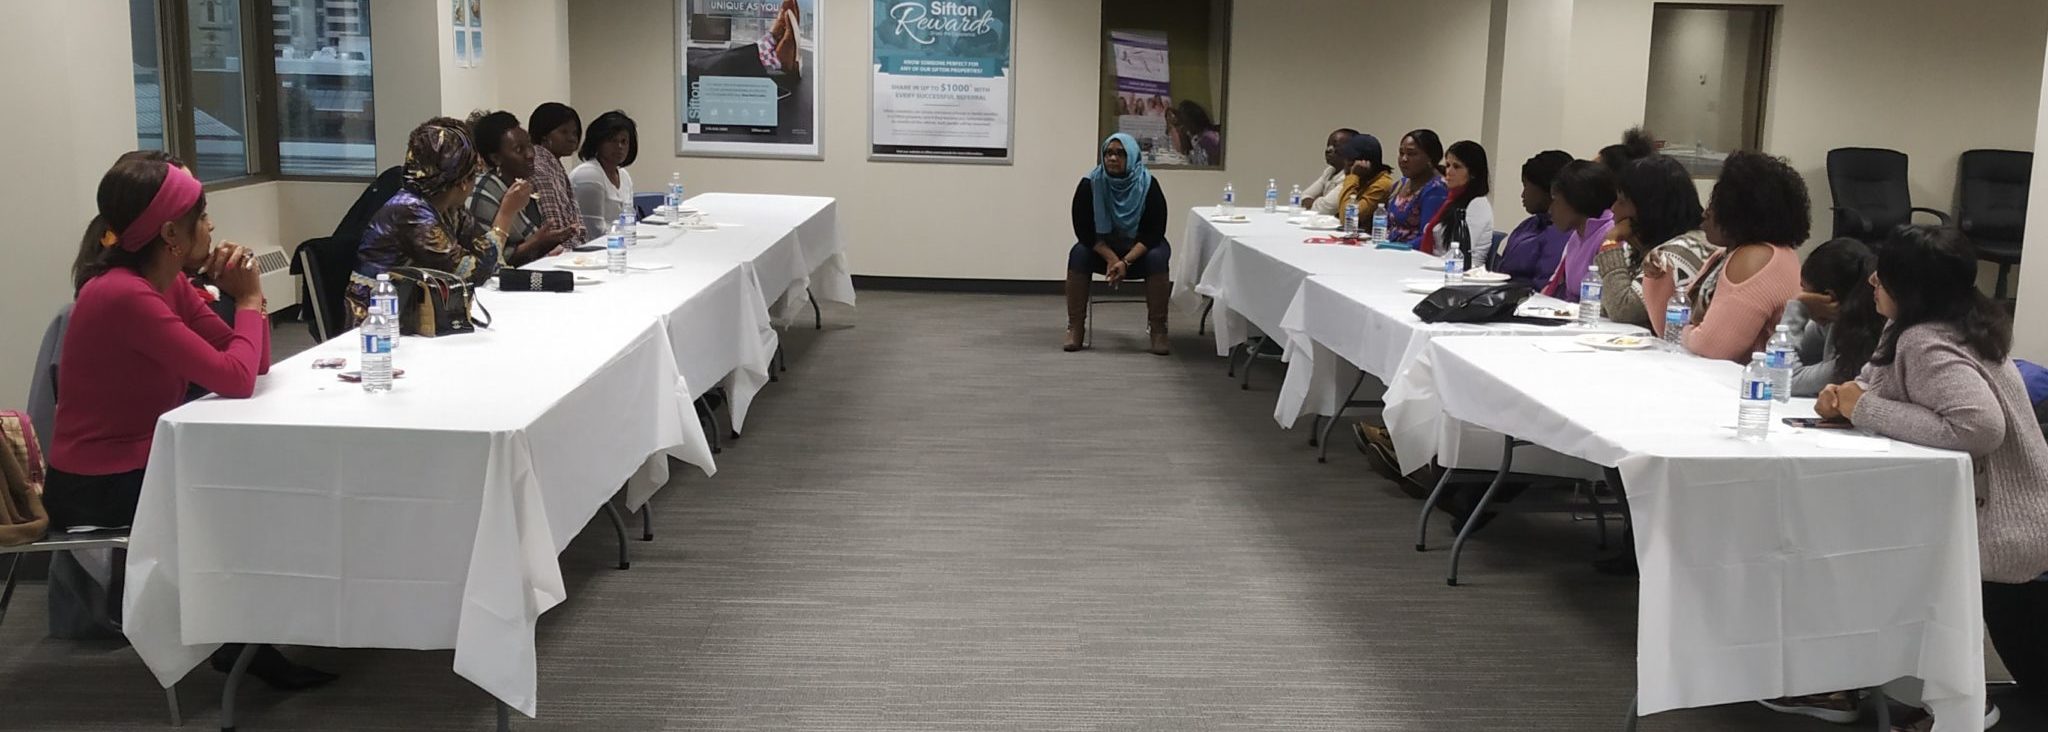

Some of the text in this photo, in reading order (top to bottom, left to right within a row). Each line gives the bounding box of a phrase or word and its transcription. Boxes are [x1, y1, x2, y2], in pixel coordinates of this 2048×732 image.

[711, 1, 779, 11] UNIQUE AS YOU
[931, 1, 977, 17] Sifton
[890, 2, 994, 45] Rewards
[690, 81, 700, 119] Sifton
